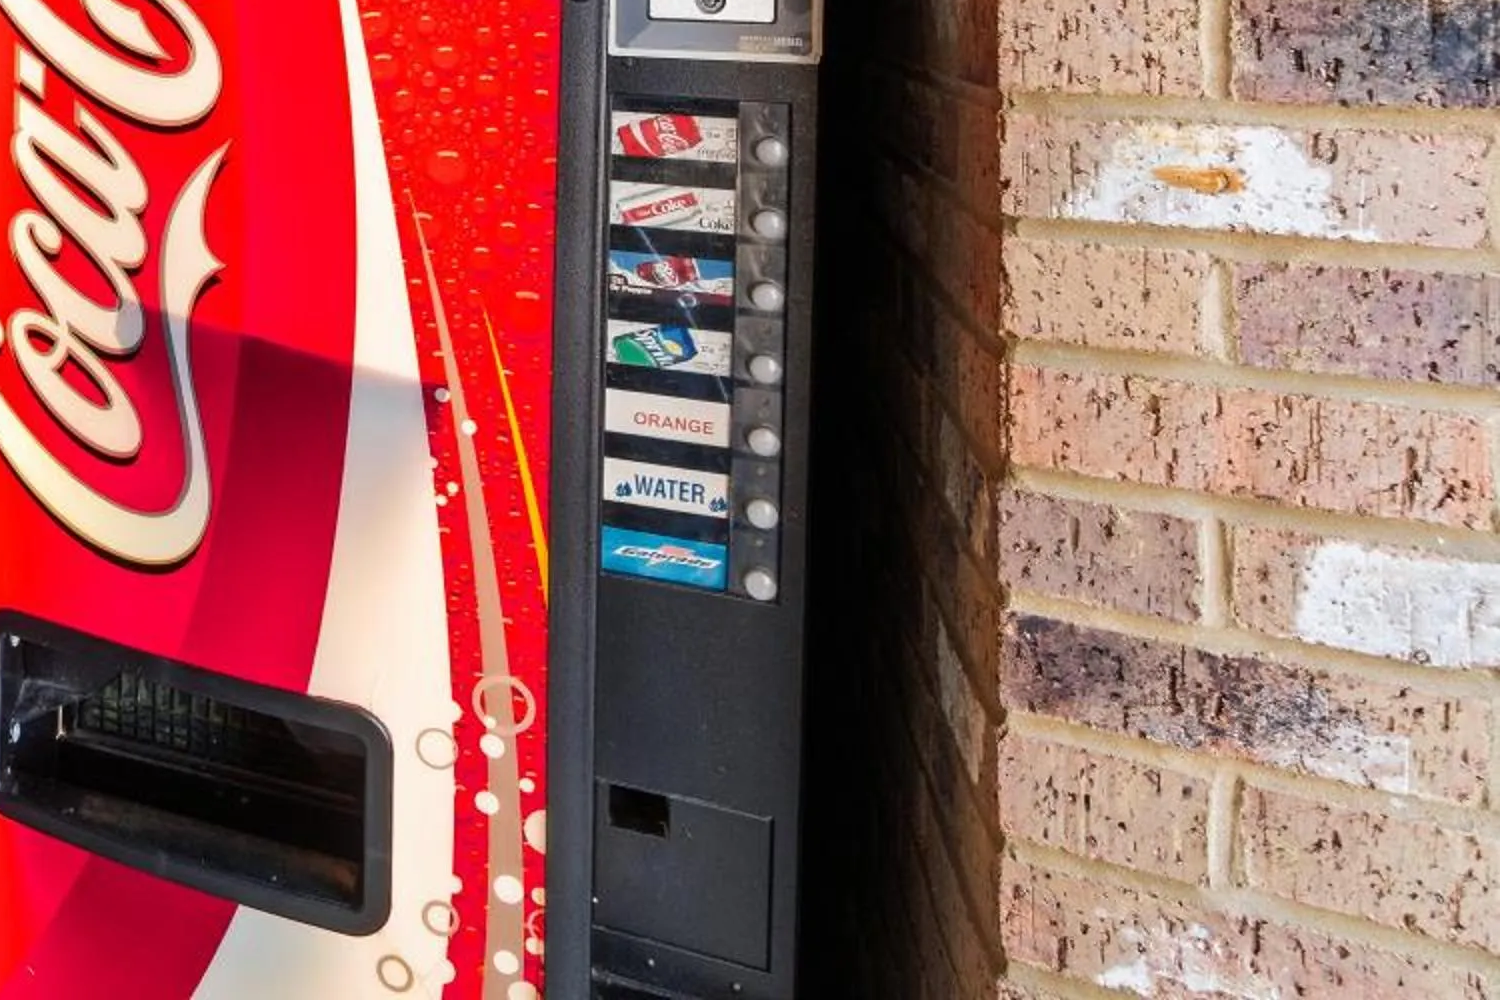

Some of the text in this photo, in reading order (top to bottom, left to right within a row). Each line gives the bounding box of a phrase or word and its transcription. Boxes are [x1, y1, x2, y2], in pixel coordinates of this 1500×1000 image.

[634, 411, 714, 434] ORANGE
[634, 474, 705, 504] WATER
[620, 547, 714, 568] Gatorade
